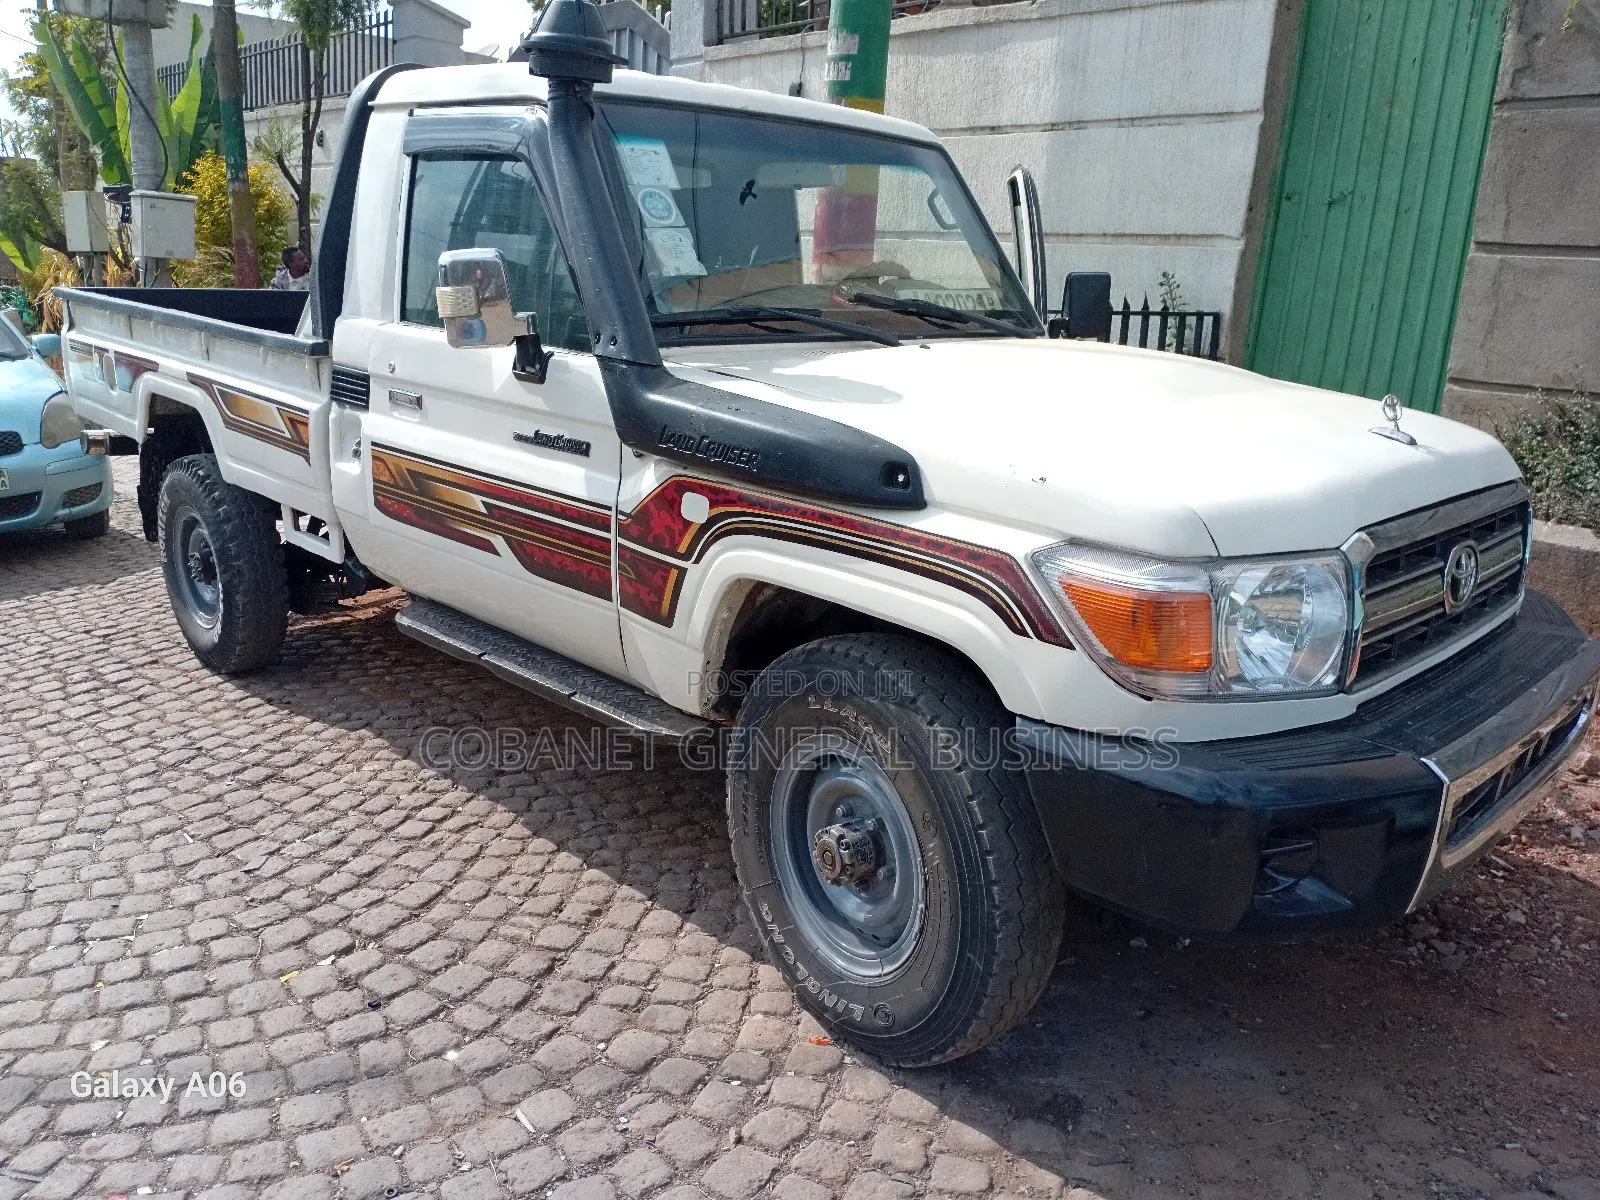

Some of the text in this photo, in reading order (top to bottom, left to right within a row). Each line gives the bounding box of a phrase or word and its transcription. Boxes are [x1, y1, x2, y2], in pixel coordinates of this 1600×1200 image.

[657, 425, 762, 472] LAND CRUISER
[759, 902, 865, 1022] LINGLONG
